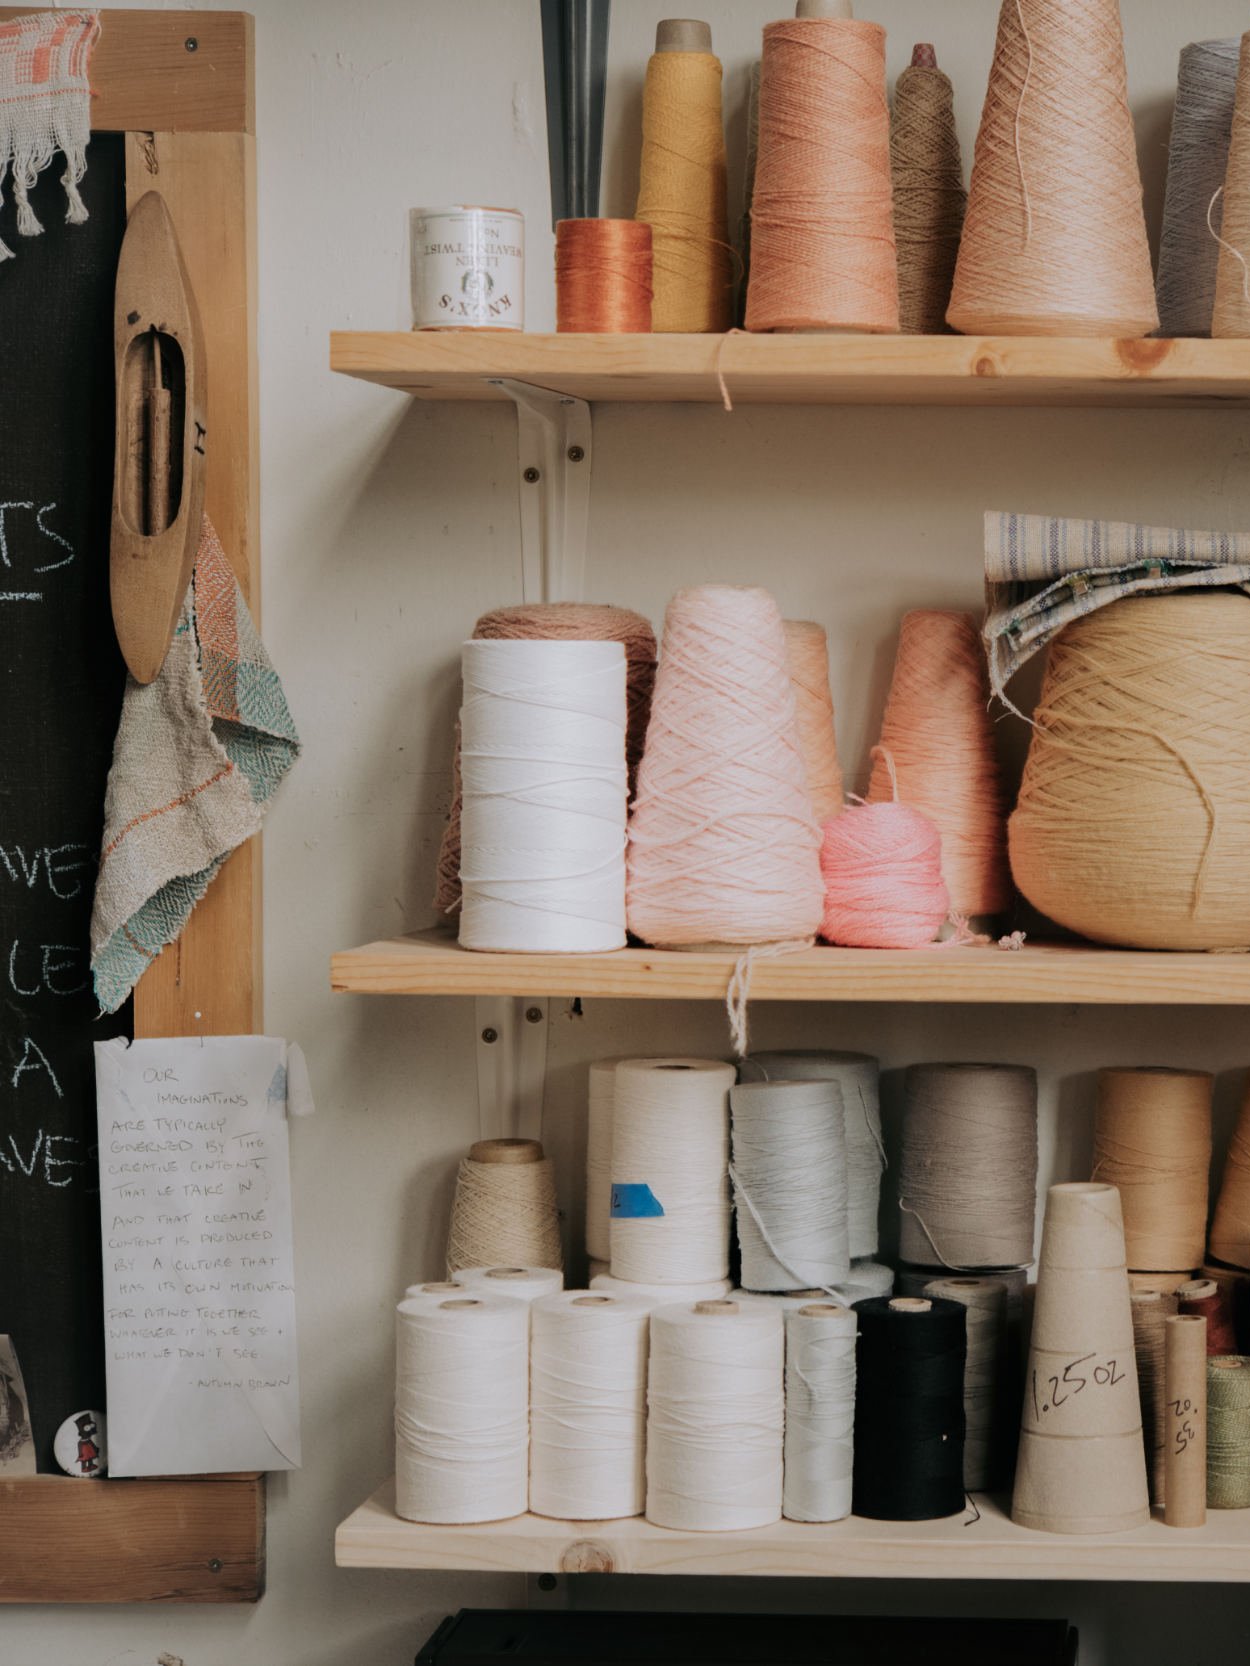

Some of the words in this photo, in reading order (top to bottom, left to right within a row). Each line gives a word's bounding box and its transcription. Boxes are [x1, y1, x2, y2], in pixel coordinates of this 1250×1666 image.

[423, 242, 464, 256] TWIST
[12, 1036, 64, 1099] A
[143, 1068, 179, 1083] OUR
[111, 1120, 145, 1134] ARE
[155, 1117, 227, 1131] TYPICALLY
[206, 1141, 225, 1154] BY
[108, 1161, 179, 1174] CREATIVE
[112, 1182, 146, 1199] THAT
[183, 1183, 224, 1197] TAKE
[239, 1180, 253, 1193] IN
[112, 1216, 145, 1230] AND
[157, 1213, 192, 1225] THAT
[205, 1209, 266, 1223] CREATIVE
[109, 1237, 165, 1249] CONTENT
[175, 1236, 189, 1246] IS
[200, 1230, 273, 1244] PRODUCED
[114, 1259, 135, 1272] BY
[152, 1257, 162, 1271] A
[175, 1259, 233, 1271] CULTURE
[240, 1257, 280, 1268] THAT
[119, 1283, 145, 1294] HAS
[109, 1309, 136, 1319] FOR
[197, 1307, 262, 1320] TOGETHER
[110, 1328, 176, 1339] WHATEVER
[206, 1328, 216, 1336] IS
[249, 1327, 268, 1336] SEE
[153, 1348, 171, 1358] WE
